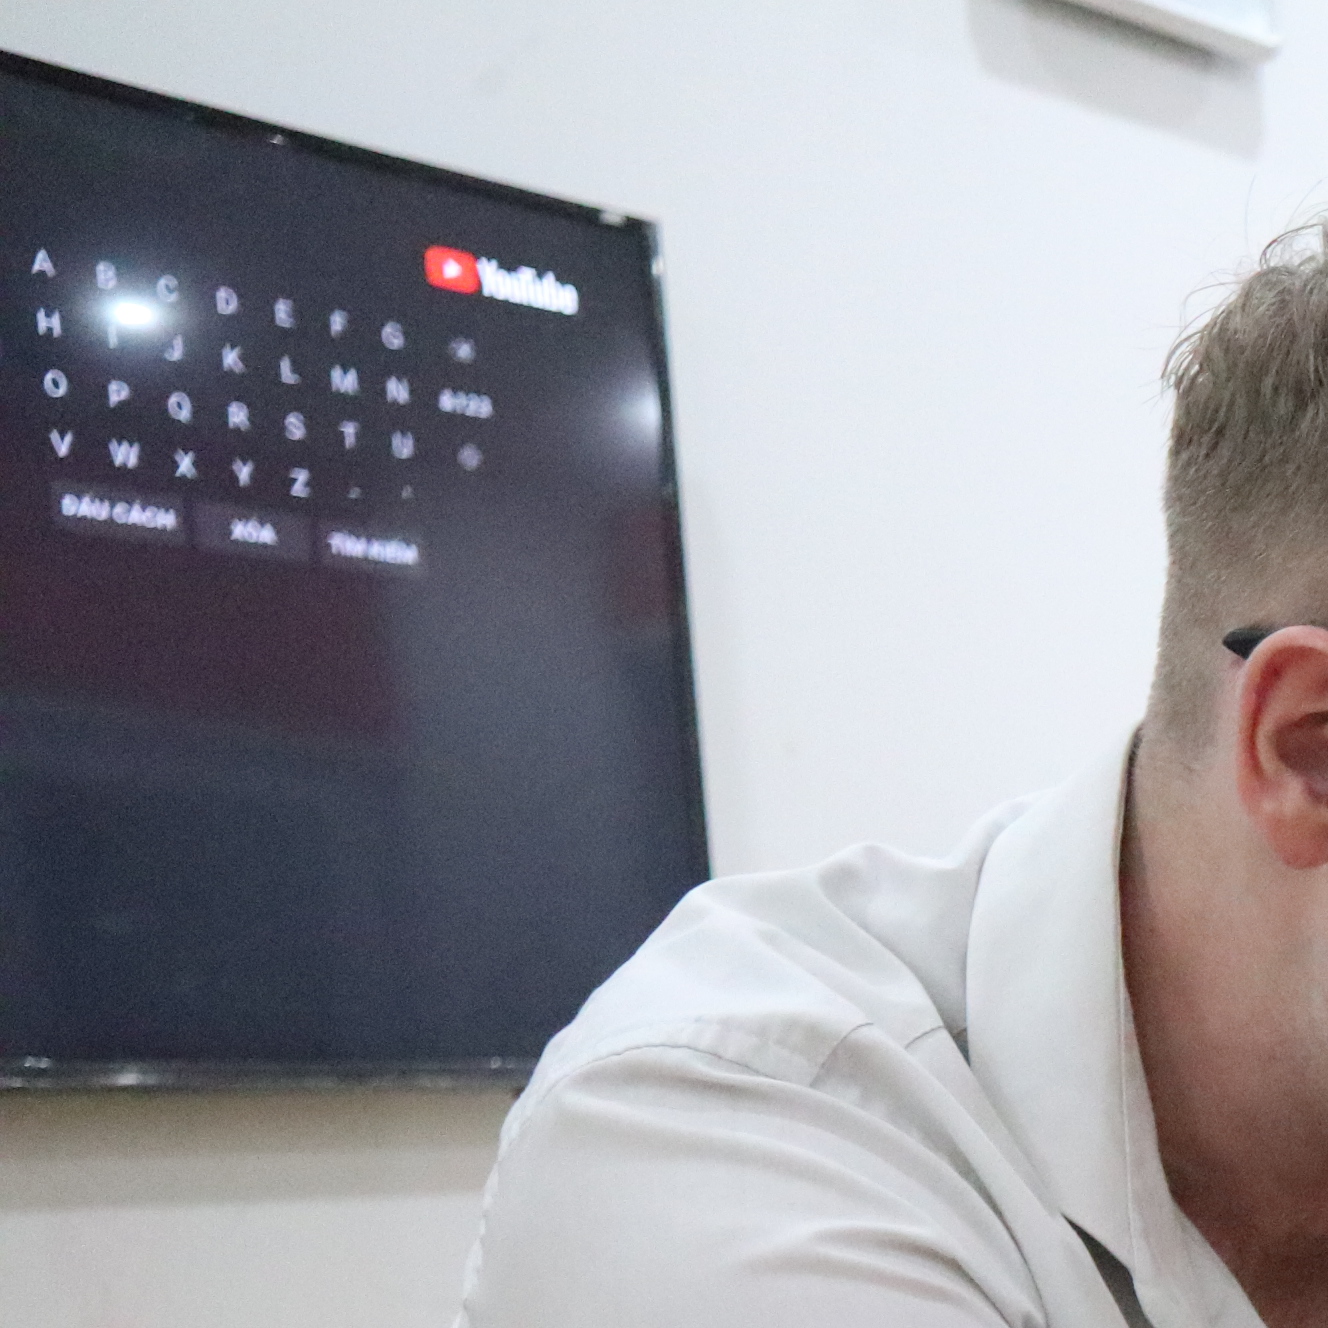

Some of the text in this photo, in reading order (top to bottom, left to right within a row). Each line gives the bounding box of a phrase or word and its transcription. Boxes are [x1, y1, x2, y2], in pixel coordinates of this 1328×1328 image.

[31, 248, 56, 278] A
[96, 260, 117, 290] B
[157, 274, 179, 302] C
[216, 285, 238, 315] D
[274, 298, 296, 328] E
[330, 308, 348, 339] F
[476, 256, 580, 316] YouTube
[36, 307, 62, 338] H
[164, 333, 184, 362] J
[222, 343, 247, 375] K
[279, 354, 300, 385] L
[330, 365, 360, 395] M
[385, 375, 410, 405] N
[43, 368, 414, 459] O P Q R S T U
[49, 428, 311, 498] V W X Y Z
